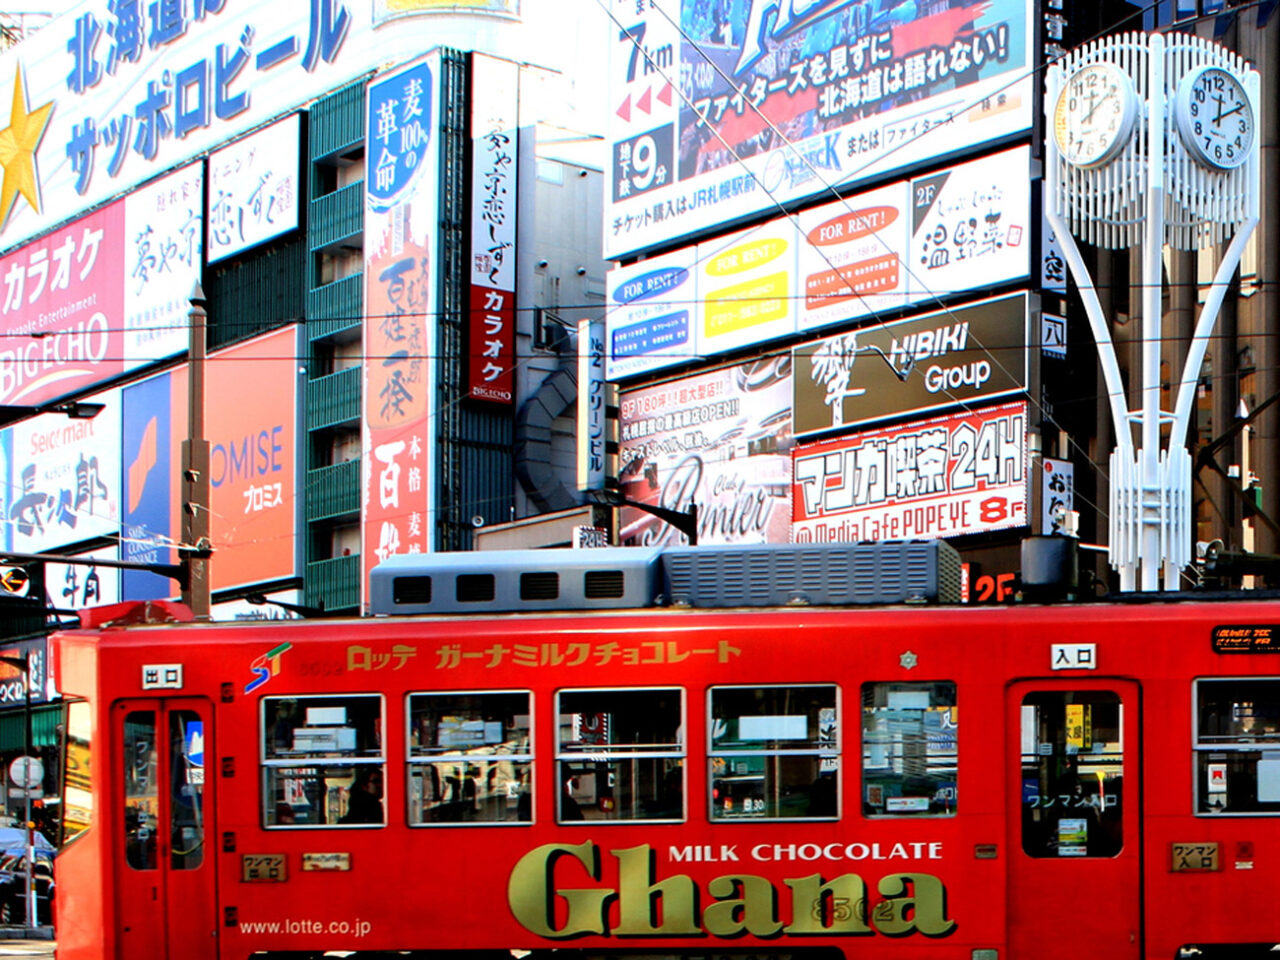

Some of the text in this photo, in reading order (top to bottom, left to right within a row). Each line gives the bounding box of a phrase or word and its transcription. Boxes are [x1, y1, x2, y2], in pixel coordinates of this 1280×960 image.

[66, 0, 226, 95] 北海道
[694, 30, 892, 128] ファイターズを見ずに
[820, 24, 1010, 118] 北海道は語れない!
[66, 0, 353, 196] サッポロビール
[375, 99, 400, 192] 革命
[847, 131, 880, 157] または
[619, 142, 632, 198] 地下鉄
[612, 171, 757, 236] チケット購入はJR札幌駅前
[916, 184, 936, 208] 2F
[820, 222, 843, 242] FOR
[2, 227, 105, 315] カラオケ
[623, 282, 643, 299] FOR
[42, 311, 109, 371] ECHO
[481, 290, 505, 382] カラオケ
[888, 322, 969, 371] HIBIKI
[924, 360, 991, 394] Group
[795, 414, 1025, 517] マンガ喫茶24H
[243, 482, 282, 514] プロミス
[903, 500, 972, 536] POPEYE
[347, 640, 741, 671] ロッテ ガーナミルクチョコレート
[1056, 648, 1092, 664] 入口
[146, 670, 178, 683] 出口
[669, 842, 943, 862] MILK CHOCOLATE
[1173, 845, 1217, 857] ワンマン
[1179, 858, 1213, 869] 入口
[508, 839, 954, 942] Ghana
[240, 919, 371, 937] www.lotte.co.jp
